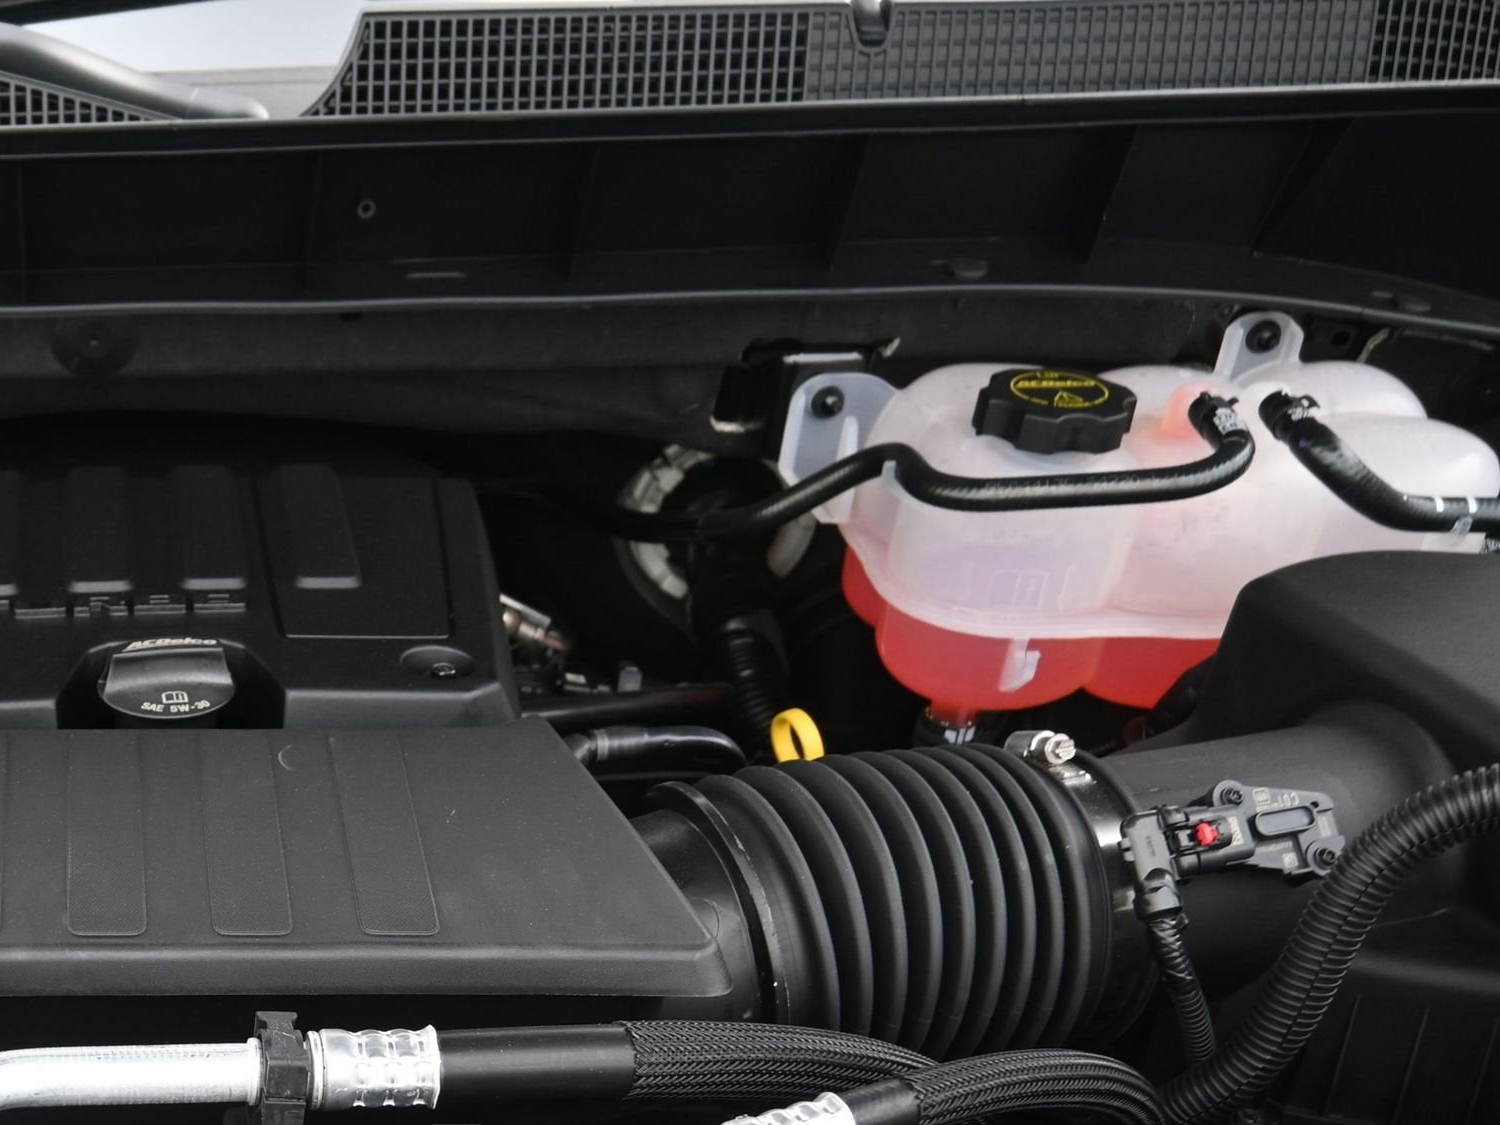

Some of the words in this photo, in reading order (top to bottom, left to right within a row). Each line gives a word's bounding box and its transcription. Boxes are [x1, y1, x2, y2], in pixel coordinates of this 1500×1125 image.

[122, 637, 217, 652] ACDelco
[140, 702, 164, 713] SAE
[170, 700, 211, 713] 5W-30
